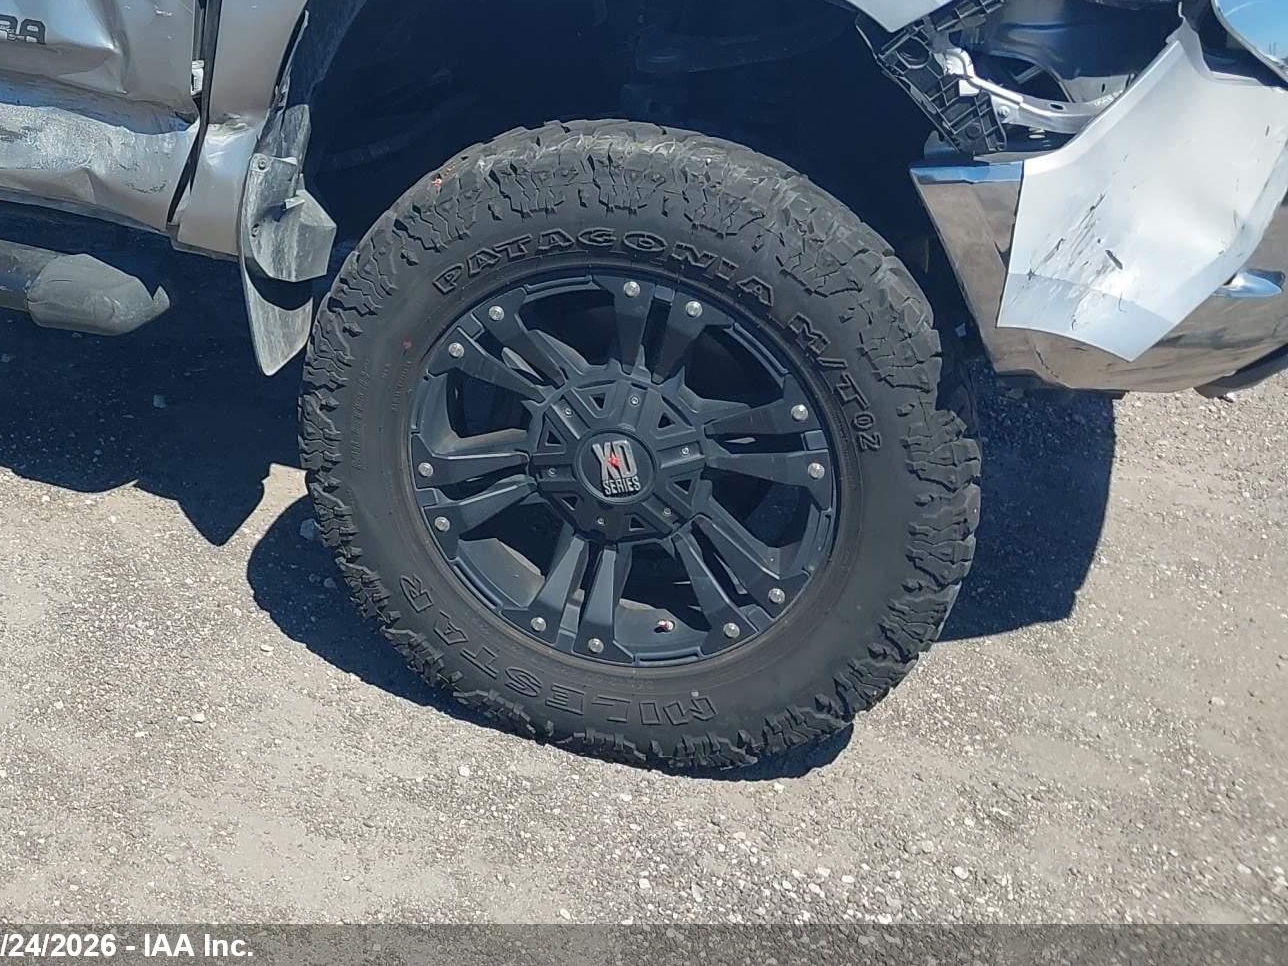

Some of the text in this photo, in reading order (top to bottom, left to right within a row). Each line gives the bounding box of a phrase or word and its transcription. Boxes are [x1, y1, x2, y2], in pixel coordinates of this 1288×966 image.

[431, 225, 777, 308] PATAGONIA
[592, 439, 638, 482] XD
[601, 475, 642, 496] SERIES
[399, 573, 719, 727] MILESTAR
